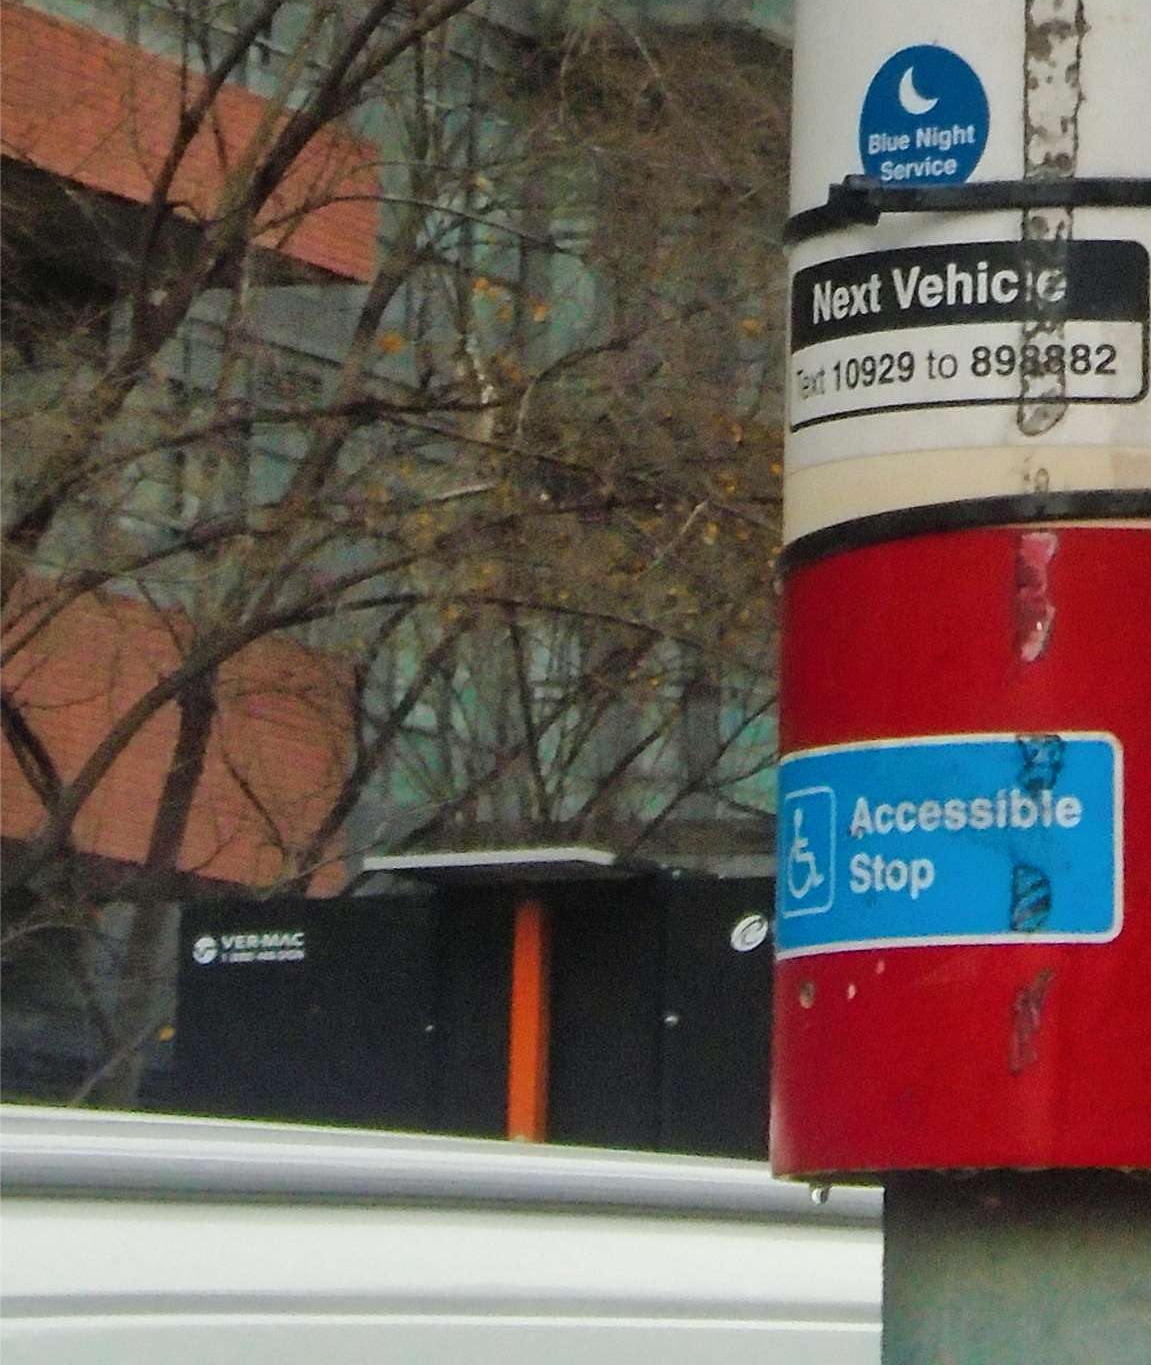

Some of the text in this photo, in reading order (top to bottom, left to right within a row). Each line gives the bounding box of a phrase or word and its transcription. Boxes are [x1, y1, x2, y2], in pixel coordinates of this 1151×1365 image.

[868, 124, 976, 155] Blue Night
[880, 156, 957, 181] Service
[812, 260, 1067, 325] Next Vehicle
[833, 350, 915, 393] 10929
[927, 349, 959, 381] to
[970, 343, 1118, 377] 898882
[849, 788, 1083, 838] Accessible
[849, 851, 936, 900] Stop
